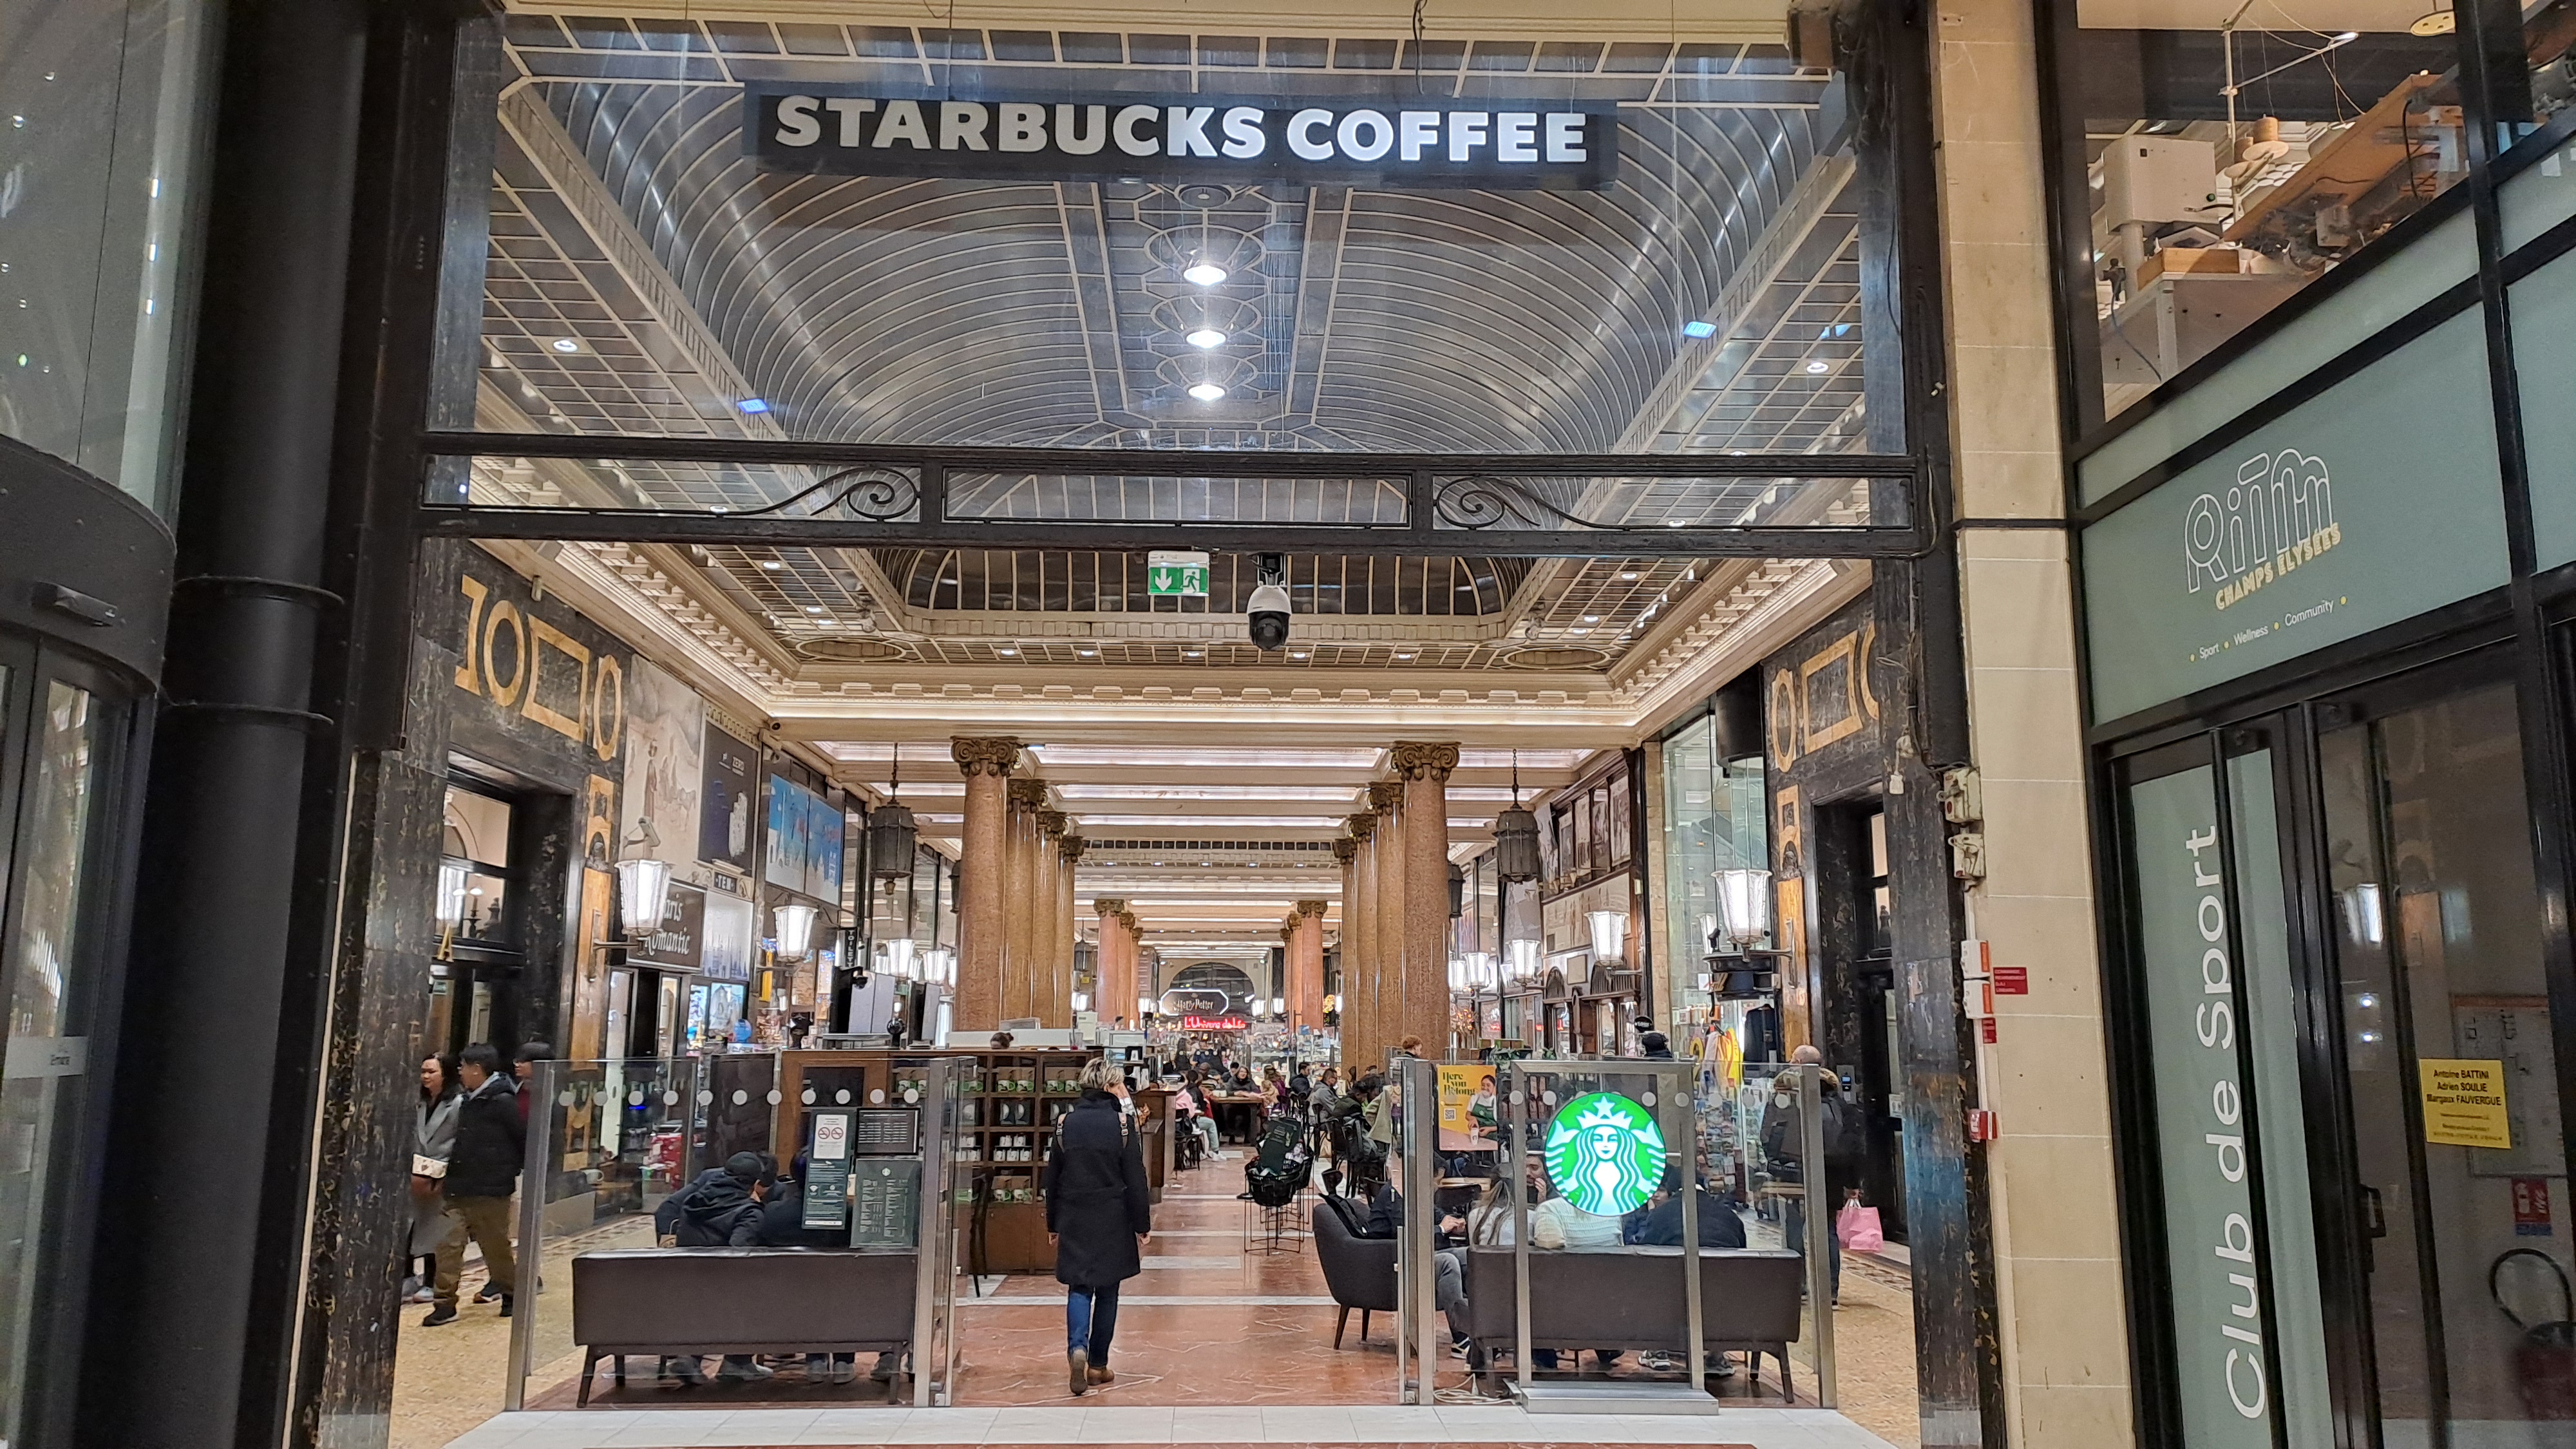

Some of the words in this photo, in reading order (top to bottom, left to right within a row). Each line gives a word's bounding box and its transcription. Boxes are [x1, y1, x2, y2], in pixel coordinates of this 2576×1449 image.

[774, 93, 1267, 160] STARBUCKS
[1287, 109, 1589, 163] COFFEE
[2214, 560, 2275, 611] CHAMPS
[2199, 642, 2220, 661] Sport
[2233, 625, 2269, 647] Wellness
[2284, 599, 2334, 627] Community
[2184, 824, 2233, 1051] Sport
[1177, 999, 1195, 1012] Harry
[1195, 998, 1214, 1010] Potter
[1443, 1072, 1463, 1083] Here
[2433, 1069, 2459, 1079] Antoine
[2460, 1069, 2489, 1079] BATTINI
[2437, 1081, 2459, 1090] Adrien
[1444, 1084, 1476, 1097] Belong
[2426, 1094, 2454, 1104] Margaux
[2456, 1094, 2502, 1106] FAUVERGUE
[2206, 1079, 2246, 1183] de
[2214, 1213, 2266, 1419] Club
